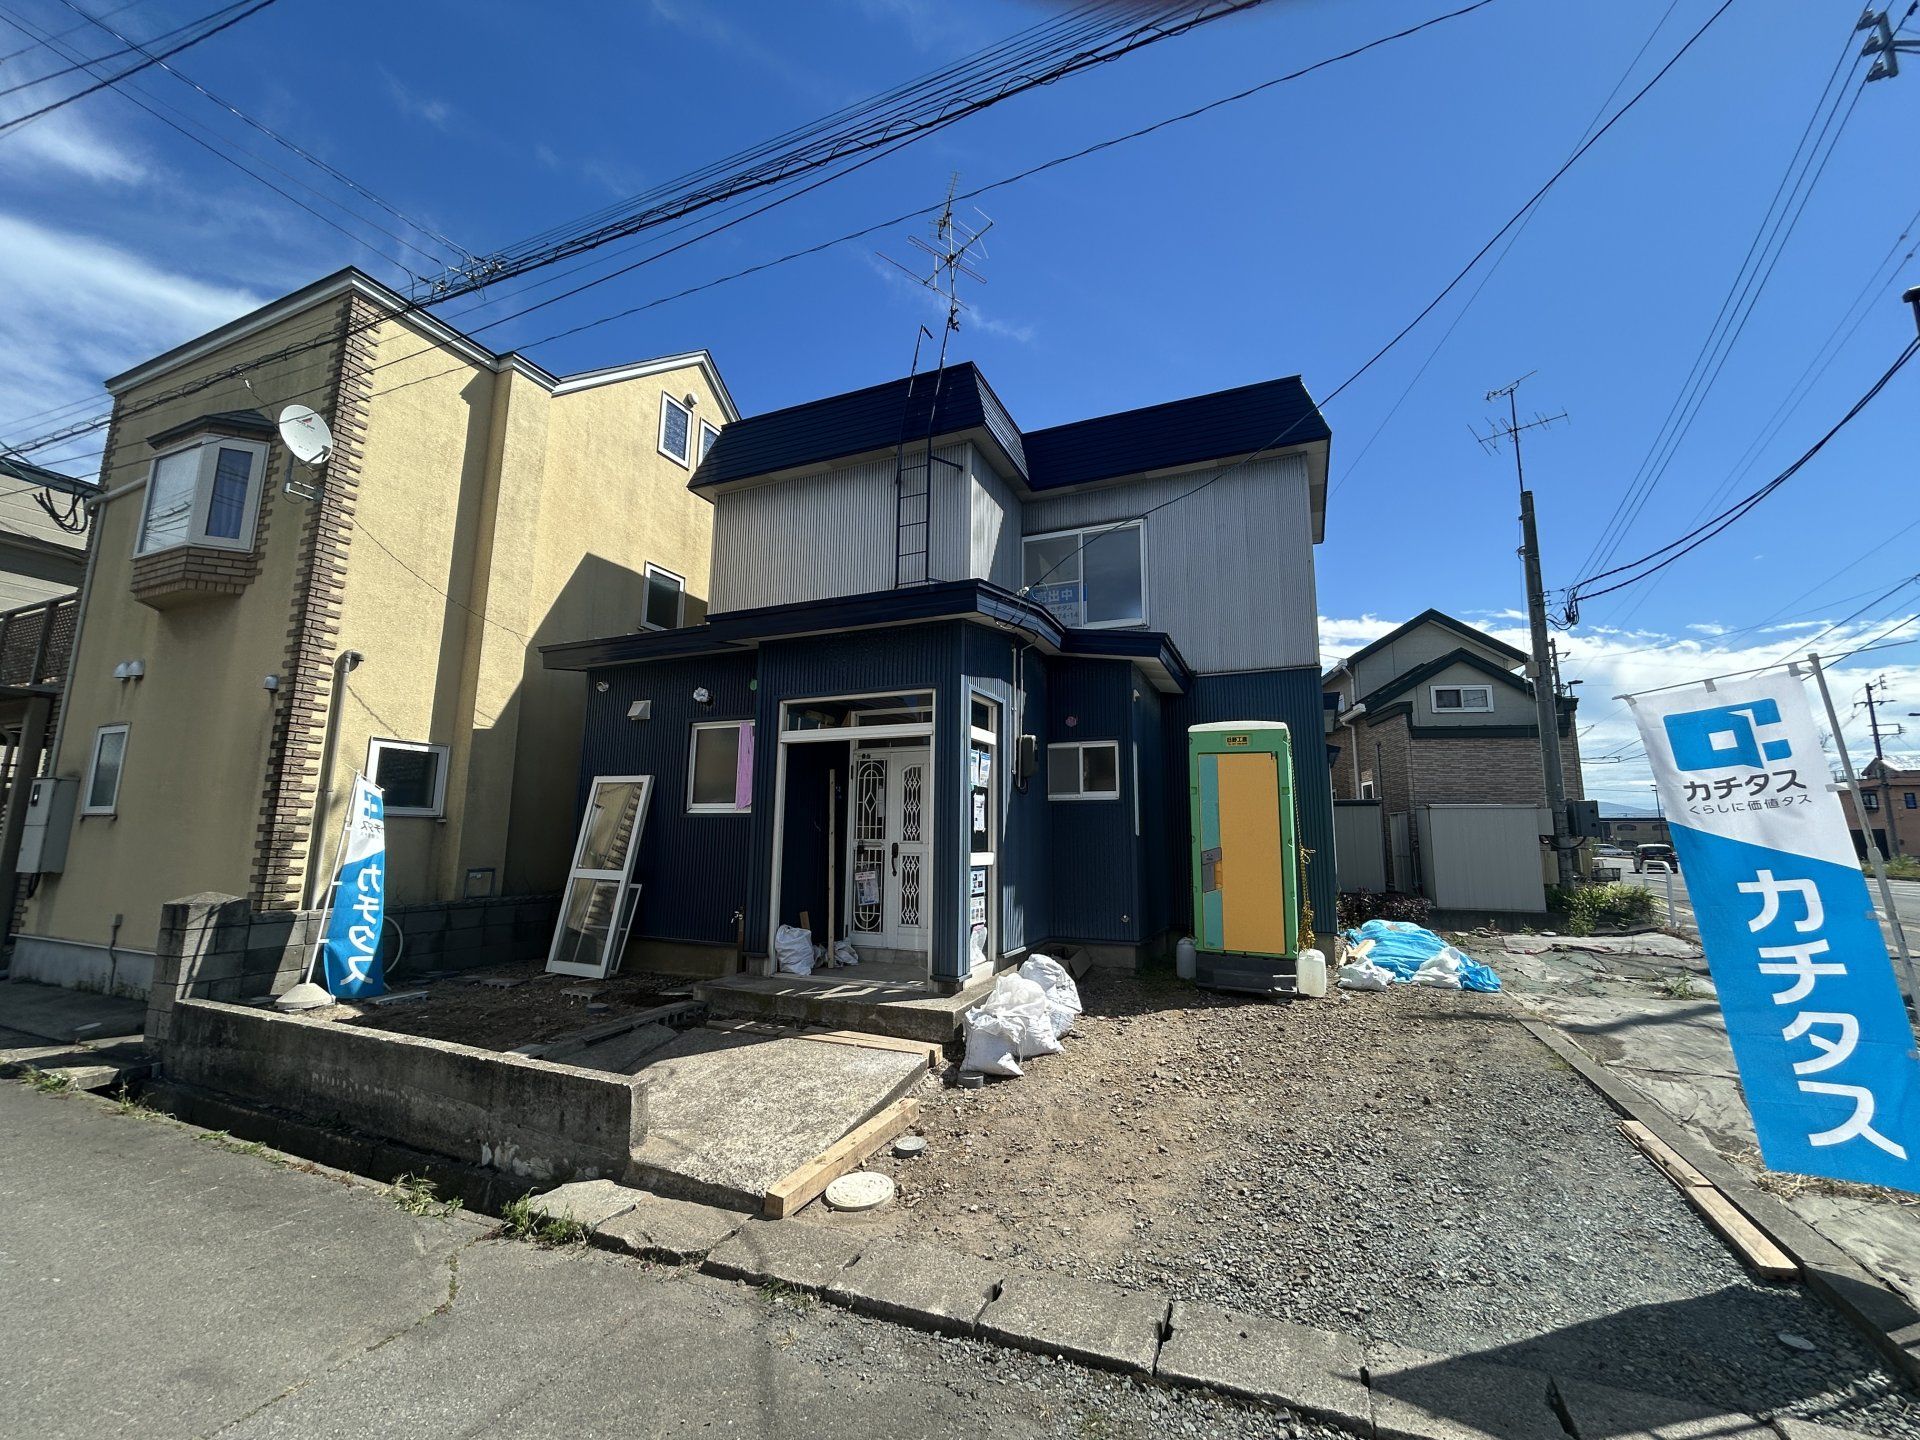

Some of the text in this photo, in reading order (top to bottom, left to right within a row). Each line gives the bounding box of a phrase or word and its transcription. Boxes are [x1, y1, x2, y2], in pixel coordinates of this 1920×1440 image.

[1683, 769, 1807, 802] カチタス
[1689, 794, 1812, 815] くらしに価値タス
[1737, 869, 1907, 1160] カチタス
